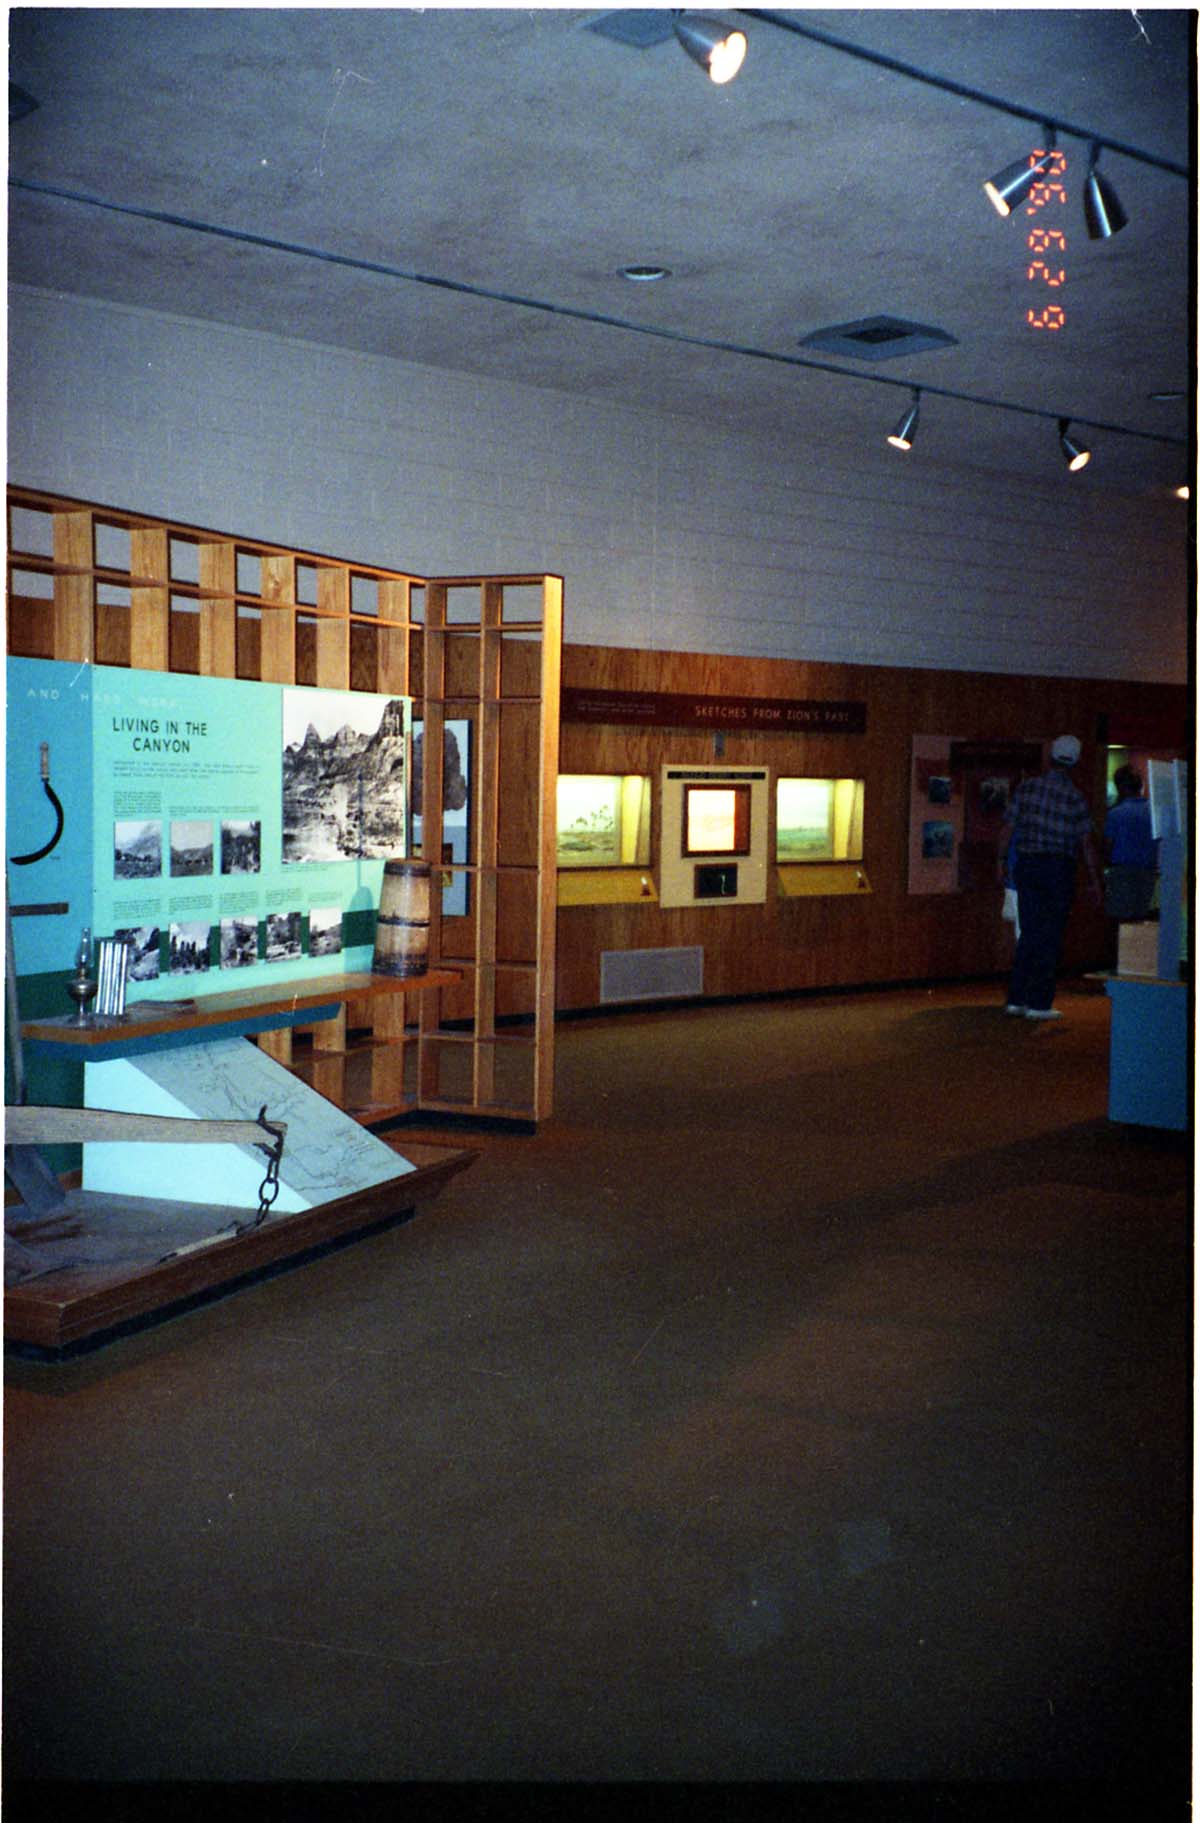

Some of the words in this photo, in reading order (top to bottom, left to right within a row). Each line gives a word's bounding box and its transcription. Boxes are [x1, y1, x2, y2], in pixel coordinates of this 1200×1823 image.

[27, 688, 60, 700] AND
[695, 705, 747, 719] SKETCHES
[753, 707, 780, 720] FROM
[112, 717, 160, 733] LIVING
[166, 721, 179, 734] IN
[186, 721, 208, 736] THE
[133, 737, 191, 753] CANYON
